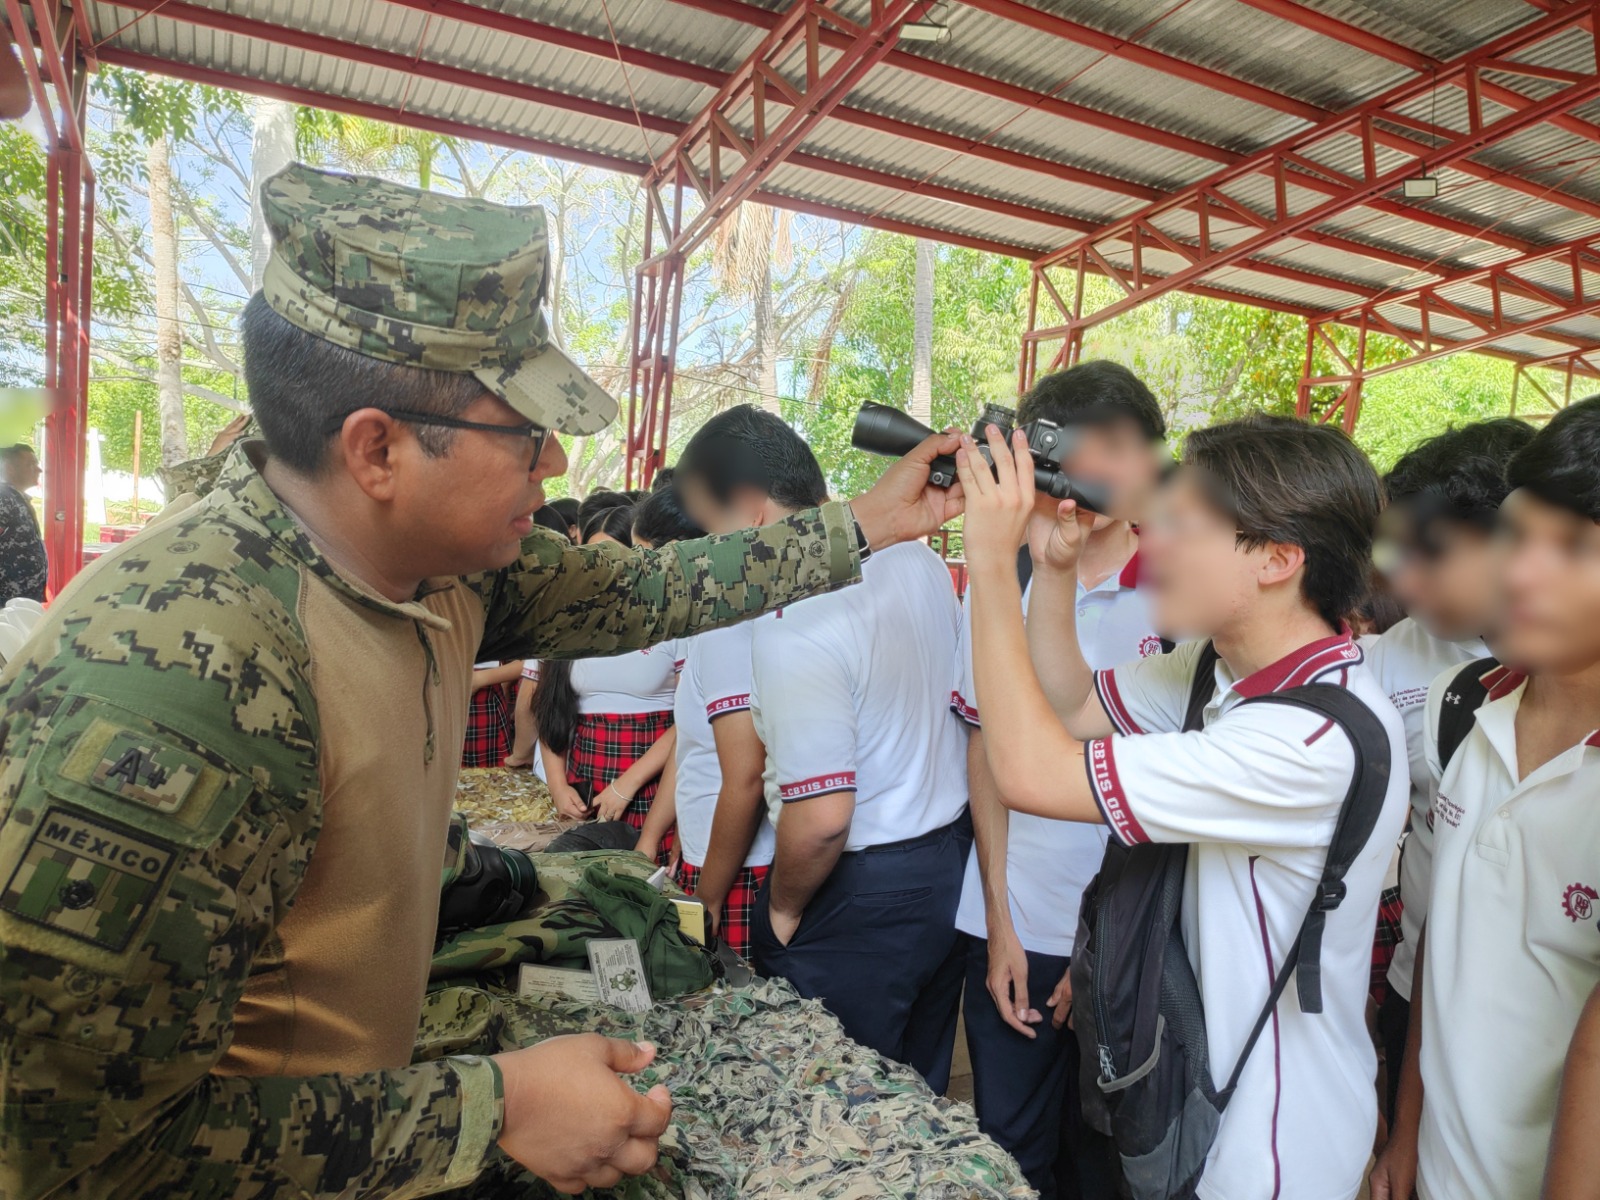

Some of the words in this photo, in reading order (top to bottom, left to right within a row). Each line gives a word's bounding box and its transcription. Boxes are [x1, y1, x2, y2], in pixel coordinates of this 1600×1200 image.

[715, 697, 751, 711] CBTIS
[787, 782, 821, 797] CBTIS
[824, 776, 848, 788] 051
[1094, 742, 1112, 792] CBTIS
[1106, 797, 1129, 828] 051
[44, 821, 161, 875] MÉXICO
